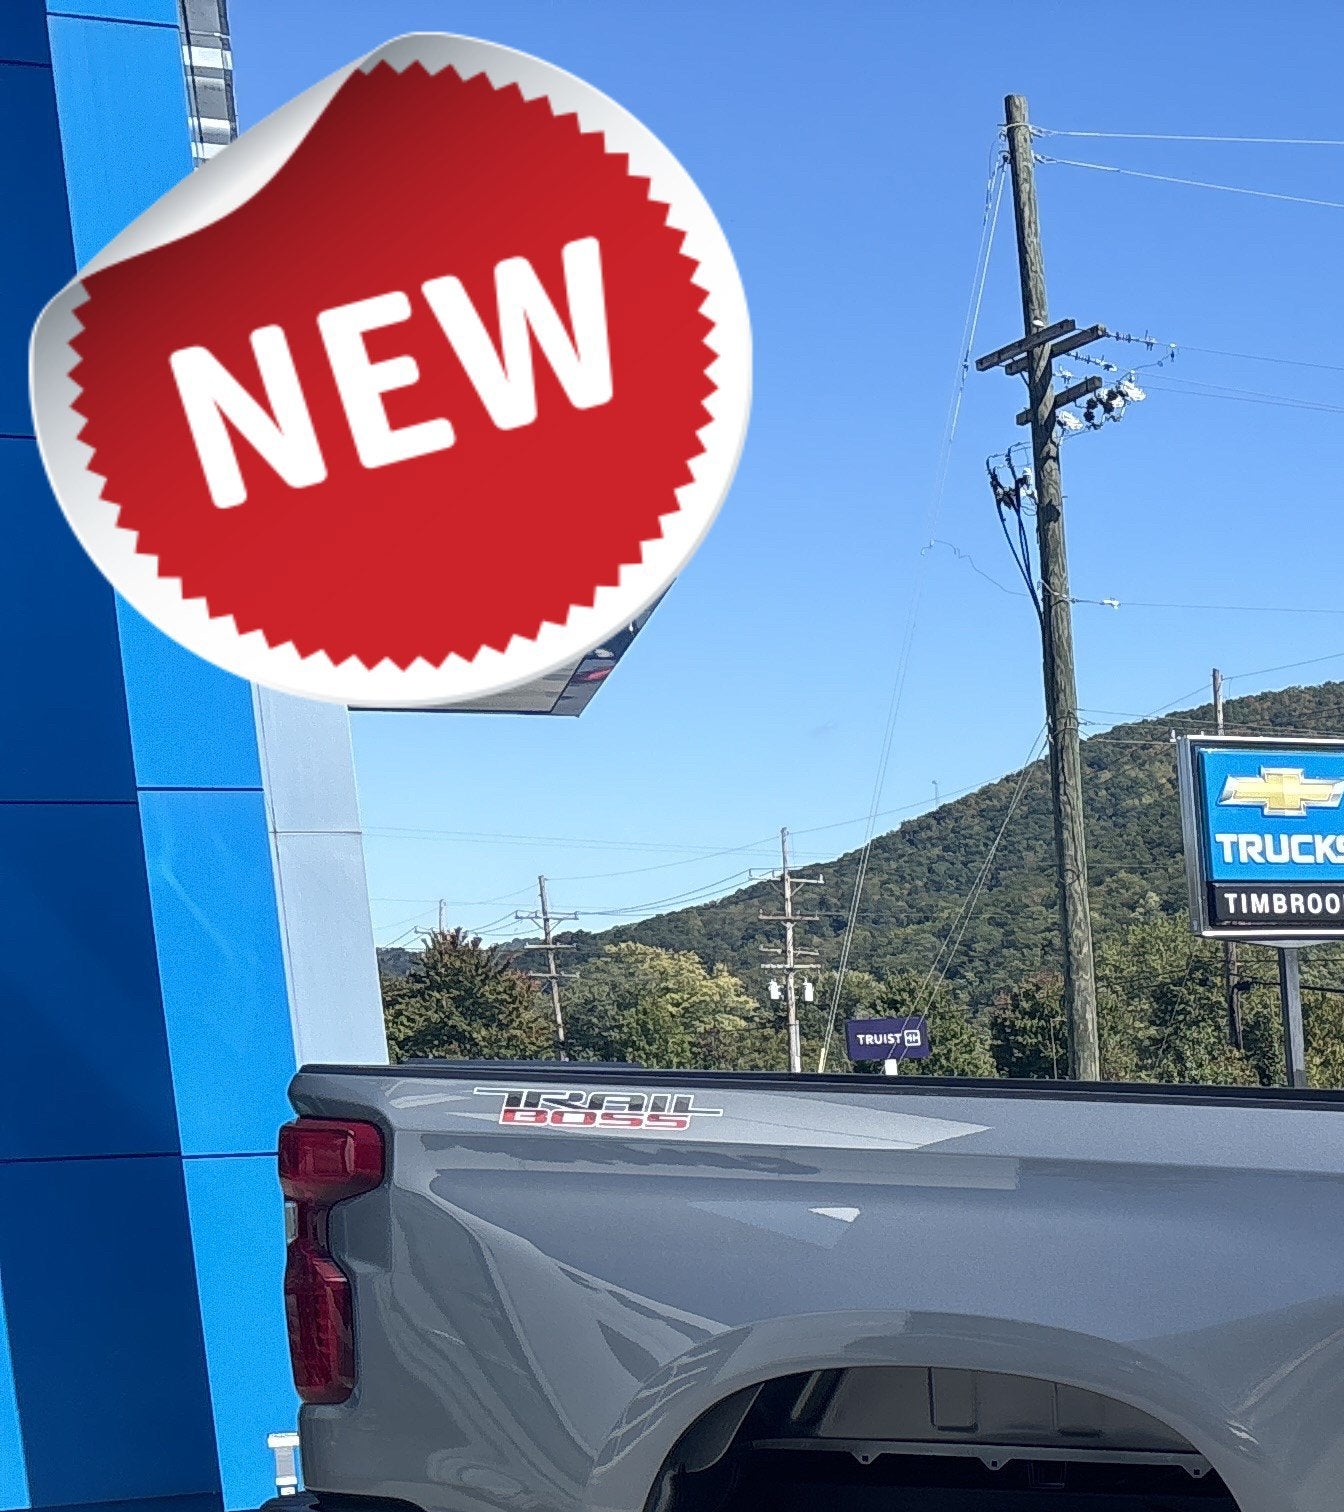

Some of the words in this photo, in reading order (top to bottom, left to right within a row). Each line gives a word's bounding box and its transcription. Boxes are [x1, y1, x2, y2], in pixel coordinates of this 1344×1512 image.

[857, 1033, 902, 1045] TRUIST
[473, 1086, 724, 1117] TRAIL
[499, 1107, 692, 1131] BOSS
